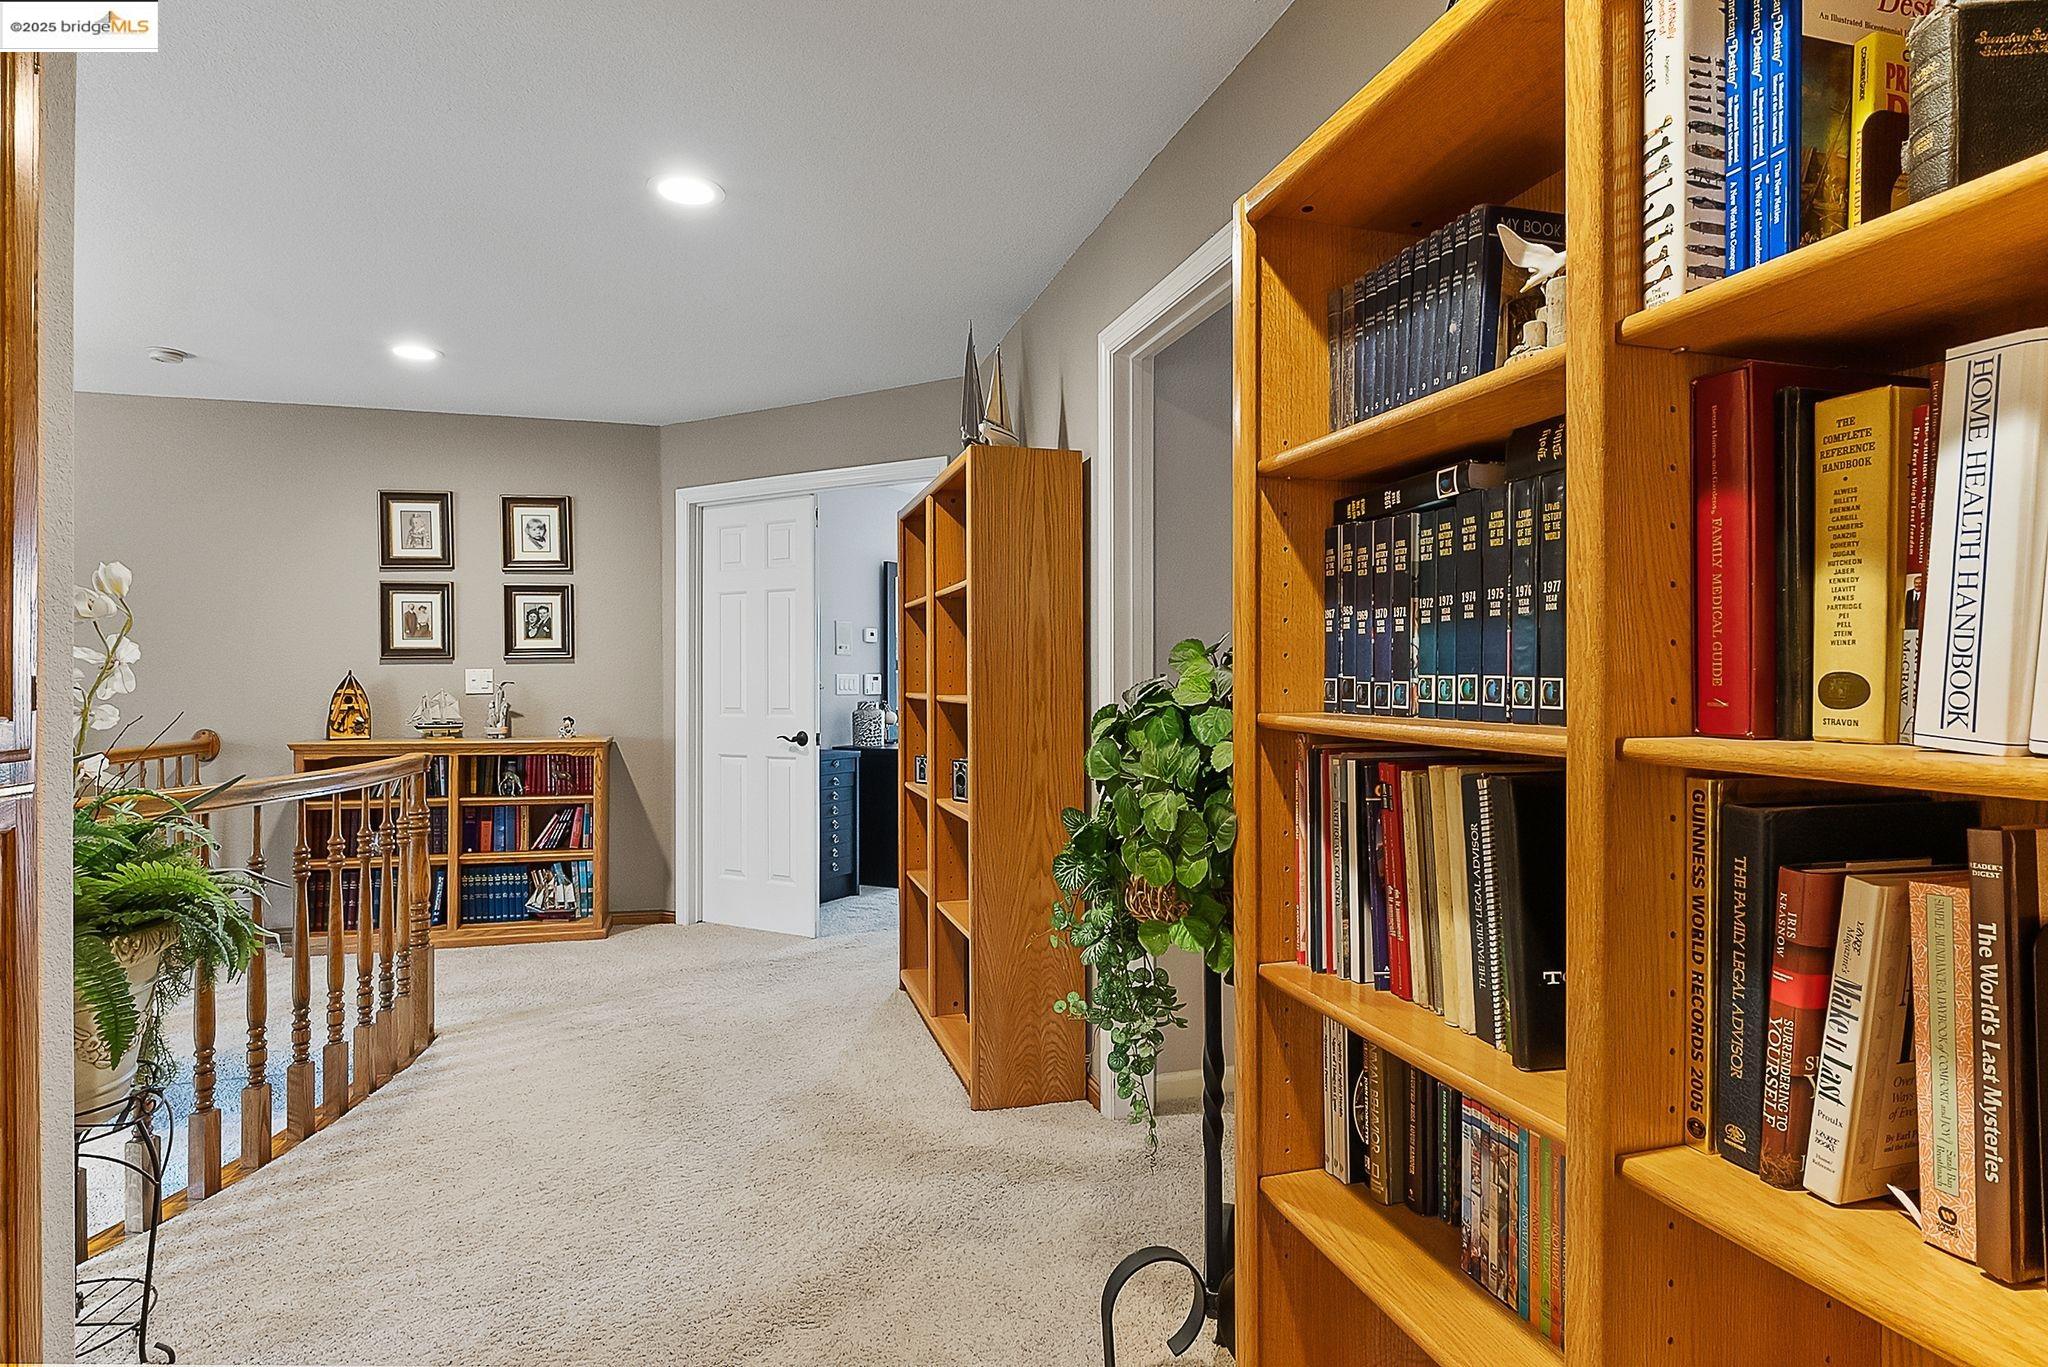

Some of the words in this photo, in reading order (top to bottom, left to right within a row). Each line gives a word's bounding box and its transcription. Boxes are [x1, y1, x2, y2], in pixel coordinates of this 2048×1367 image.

[1726, 0, 1738, 42] merican
[1751, 0, 1763, 34] erican
[1819, 12, 1829, 20] An
[1831, 14, 1863, 28] Illustrated
[1975, 30, 2029, 46] Sunday
[1752, 30, 1763, 81] Destiny
[1772, 15, 1783, 67] Destiny
[1645, 29, 1656, 98] Aircraft
[1727, 39, 1738, 89] Destiny
[1523, 220, 1562, 238] BOOK
[1755, 208, 1762, 217] of
[1729, 239, 1737, 271] Conquer
[1730, 229, 1737, 239] to
[1754, 216, 1762, 268] Independenc
[1968, 357, 1994, 442] HOME
[1823, 428, 1872, 445] COMPLETE
[1836, 416, 1855, 428] THE
[1820, 442, 1876, 460] REFERENCE
[1822, 457, 1872, 473] HANDBOOK
[1830, 505, 1860, 514] BRENNAN
[1910, 478, 1918, 504] Weight
[1959, 451, 1988, 560] HEALTH
[1828, 522, 1863, 531] CHAMBERS
[1832, 514, 1857, 522] CARGILL
[1711, 518, 1722, 568] FAMILY
[1830, 541, 1859, 549] DOHERTY
[1419, 598, 1433, 608] 1972
[1439, 594, 1453, 606] 1973
[1462, 591, 1476, 602] 1974
[1488, 588, 1504, 600] 1975
[1516, 585, 1531, 597] 1976
[1543, 580, 1561, 593] 1977
[1546, 594, 1557, 602] YEAR
[1546, 603, 1557, 611] BOOK
[1712, 574, 1722, 638] MEDICAL
[1375, 608, 1387, 619] 1970
[1394, 606, 1406, 617] 1971
[1712, 642, 1722, 686] GUIDE
[1946, 571, 1980, 730] HANDBOOK
[1823, 717, 1859, 727] STRAVON
[1470, 822, 1481, 880] ADVISOR
[1691, 789, 1705, 889] GUINNESS
[1734, 856, 1746, 888] THE
[1972, 869, 2000, 879] DIGEST
[1474, 881, 1482, 918] LEGAL
[1733, 891, 1746, 950] FAMILY
[1934, 898, 1945, 929] SIMPLE
[1475, 921, 1486, 963] FAMILY
[1691, 896, 1705, 964] WORLD
[1776, 892, 1787, 957] KRASNOW
[1786, 912, 1797, 939] IRIS
[1977, 922, 1996, 958] The
[1841, 926, 1854, 974] Magazine's
[1732, 950, 1745, 999] LEGAL
[1691, 971, 1704, 1062] RECORDS
[1828, 973, 1862, 1036] Make
[1937, 996, 1948, 1044] DAYBOOK
[1979, 963, 1999, 1036] World's
[1730, 1003, 1745, 1079] ADVISOR
[1982, 1040, 2001, 1083] Last
[1370, 1043, 1378, 1084] NIMAL
[1763, 1017, 1783, 1128] YOURSELF
[1778, 1019, 1794, 1113] SURRENDERING
[1818, 1053, 1853, 1108] Last
[1938, 1055, 1949, 1103] COMFORT
[1690, 1067, 1704, 1113] 2005
[1371, 1090, 1380, 1154] BEHAVIOR
[1776, 1115, 1788, 1132] TO
[1817, 1109, 1844, 1128] Proulx
[1978, 1086, 2003, 1184] Mysteries
[1521, 1204, 1529, 1270] KNOWLEDGE
[1531, 1209, 1539, 1277] KNOWLEDGE
[1542, 1217, 1550, 1284] KNOWLEDGE
[1552, 1223, 1560, 1291] KNOWLEDGE
